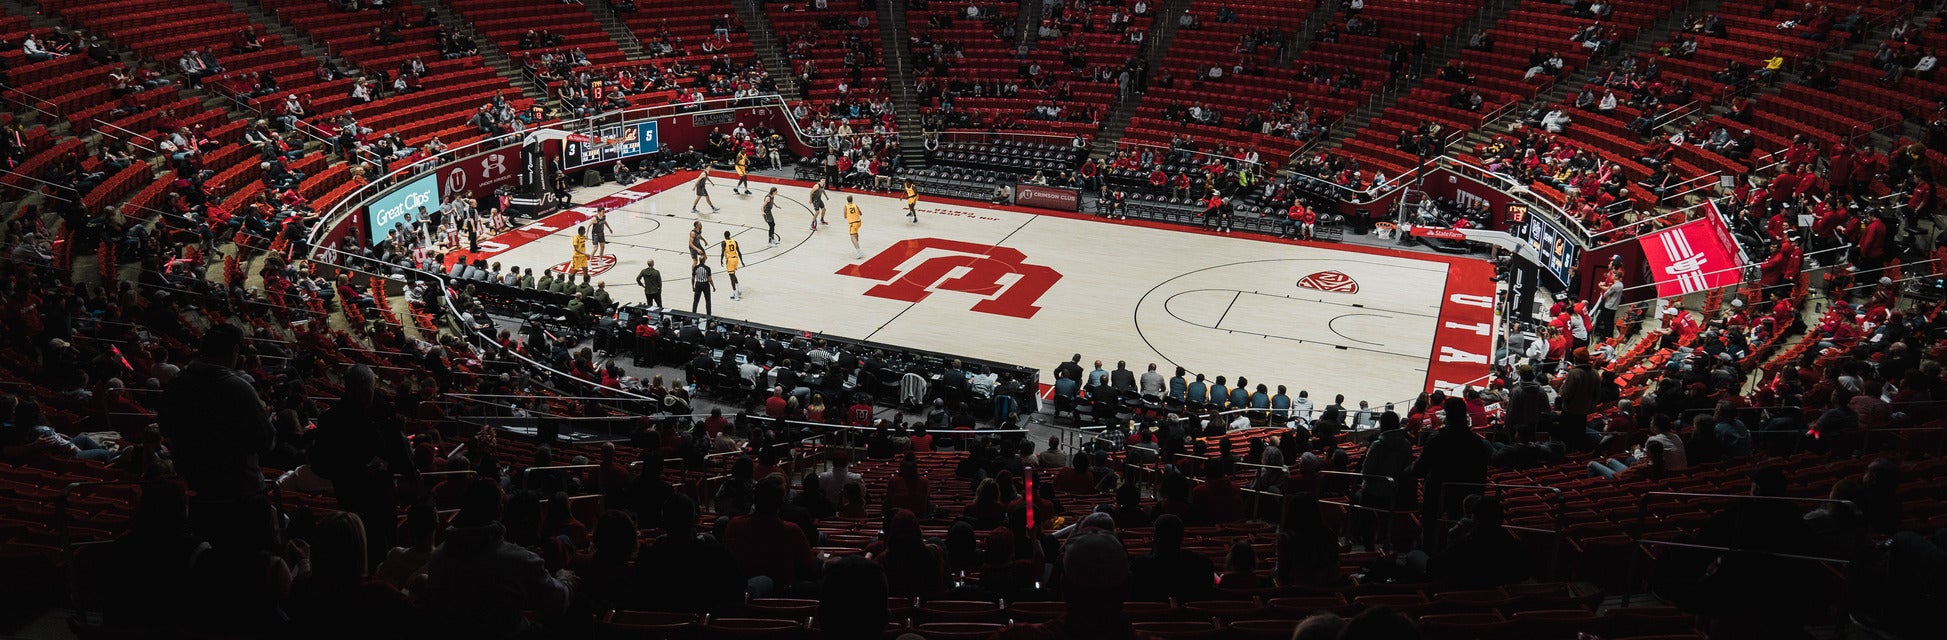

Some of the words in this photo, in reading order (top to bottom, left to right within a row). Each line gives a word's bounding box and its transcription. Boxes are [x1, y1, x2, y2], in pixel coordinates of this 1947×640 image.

[646, 130, 652, 141] 5
[568, 144, 576, 156] 3
[452, 170, 463, 190] U
[376, 202, 404, 226] Great
[404, 192, 429, 210] Clips
[728, 244, 734, 252] 13
[1432, 293, 1493, 398] UTAH
